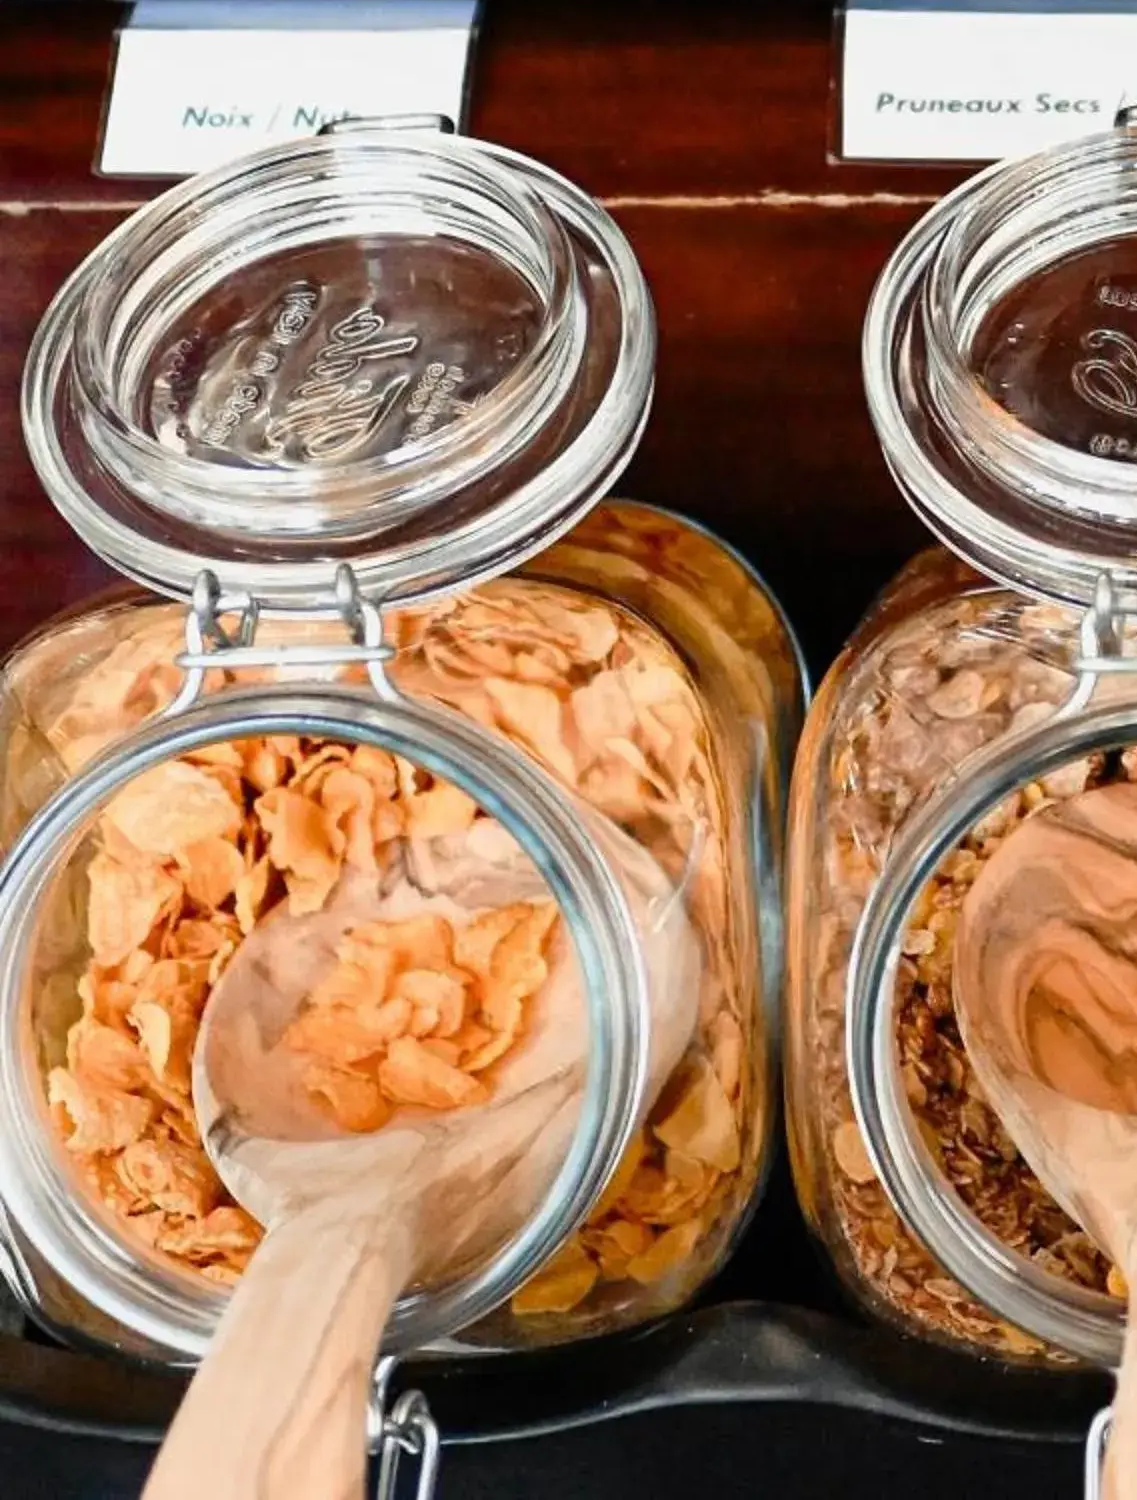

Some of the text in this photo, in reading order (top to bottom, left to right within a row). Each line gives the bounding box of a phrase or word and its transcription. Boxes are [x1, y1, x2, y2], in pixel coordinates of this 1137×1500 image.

[875, 92, 1021, 113] Pruneaux
[1035, 92, 1100, 113] Secs
[182, 105, 254, 128] Noix
